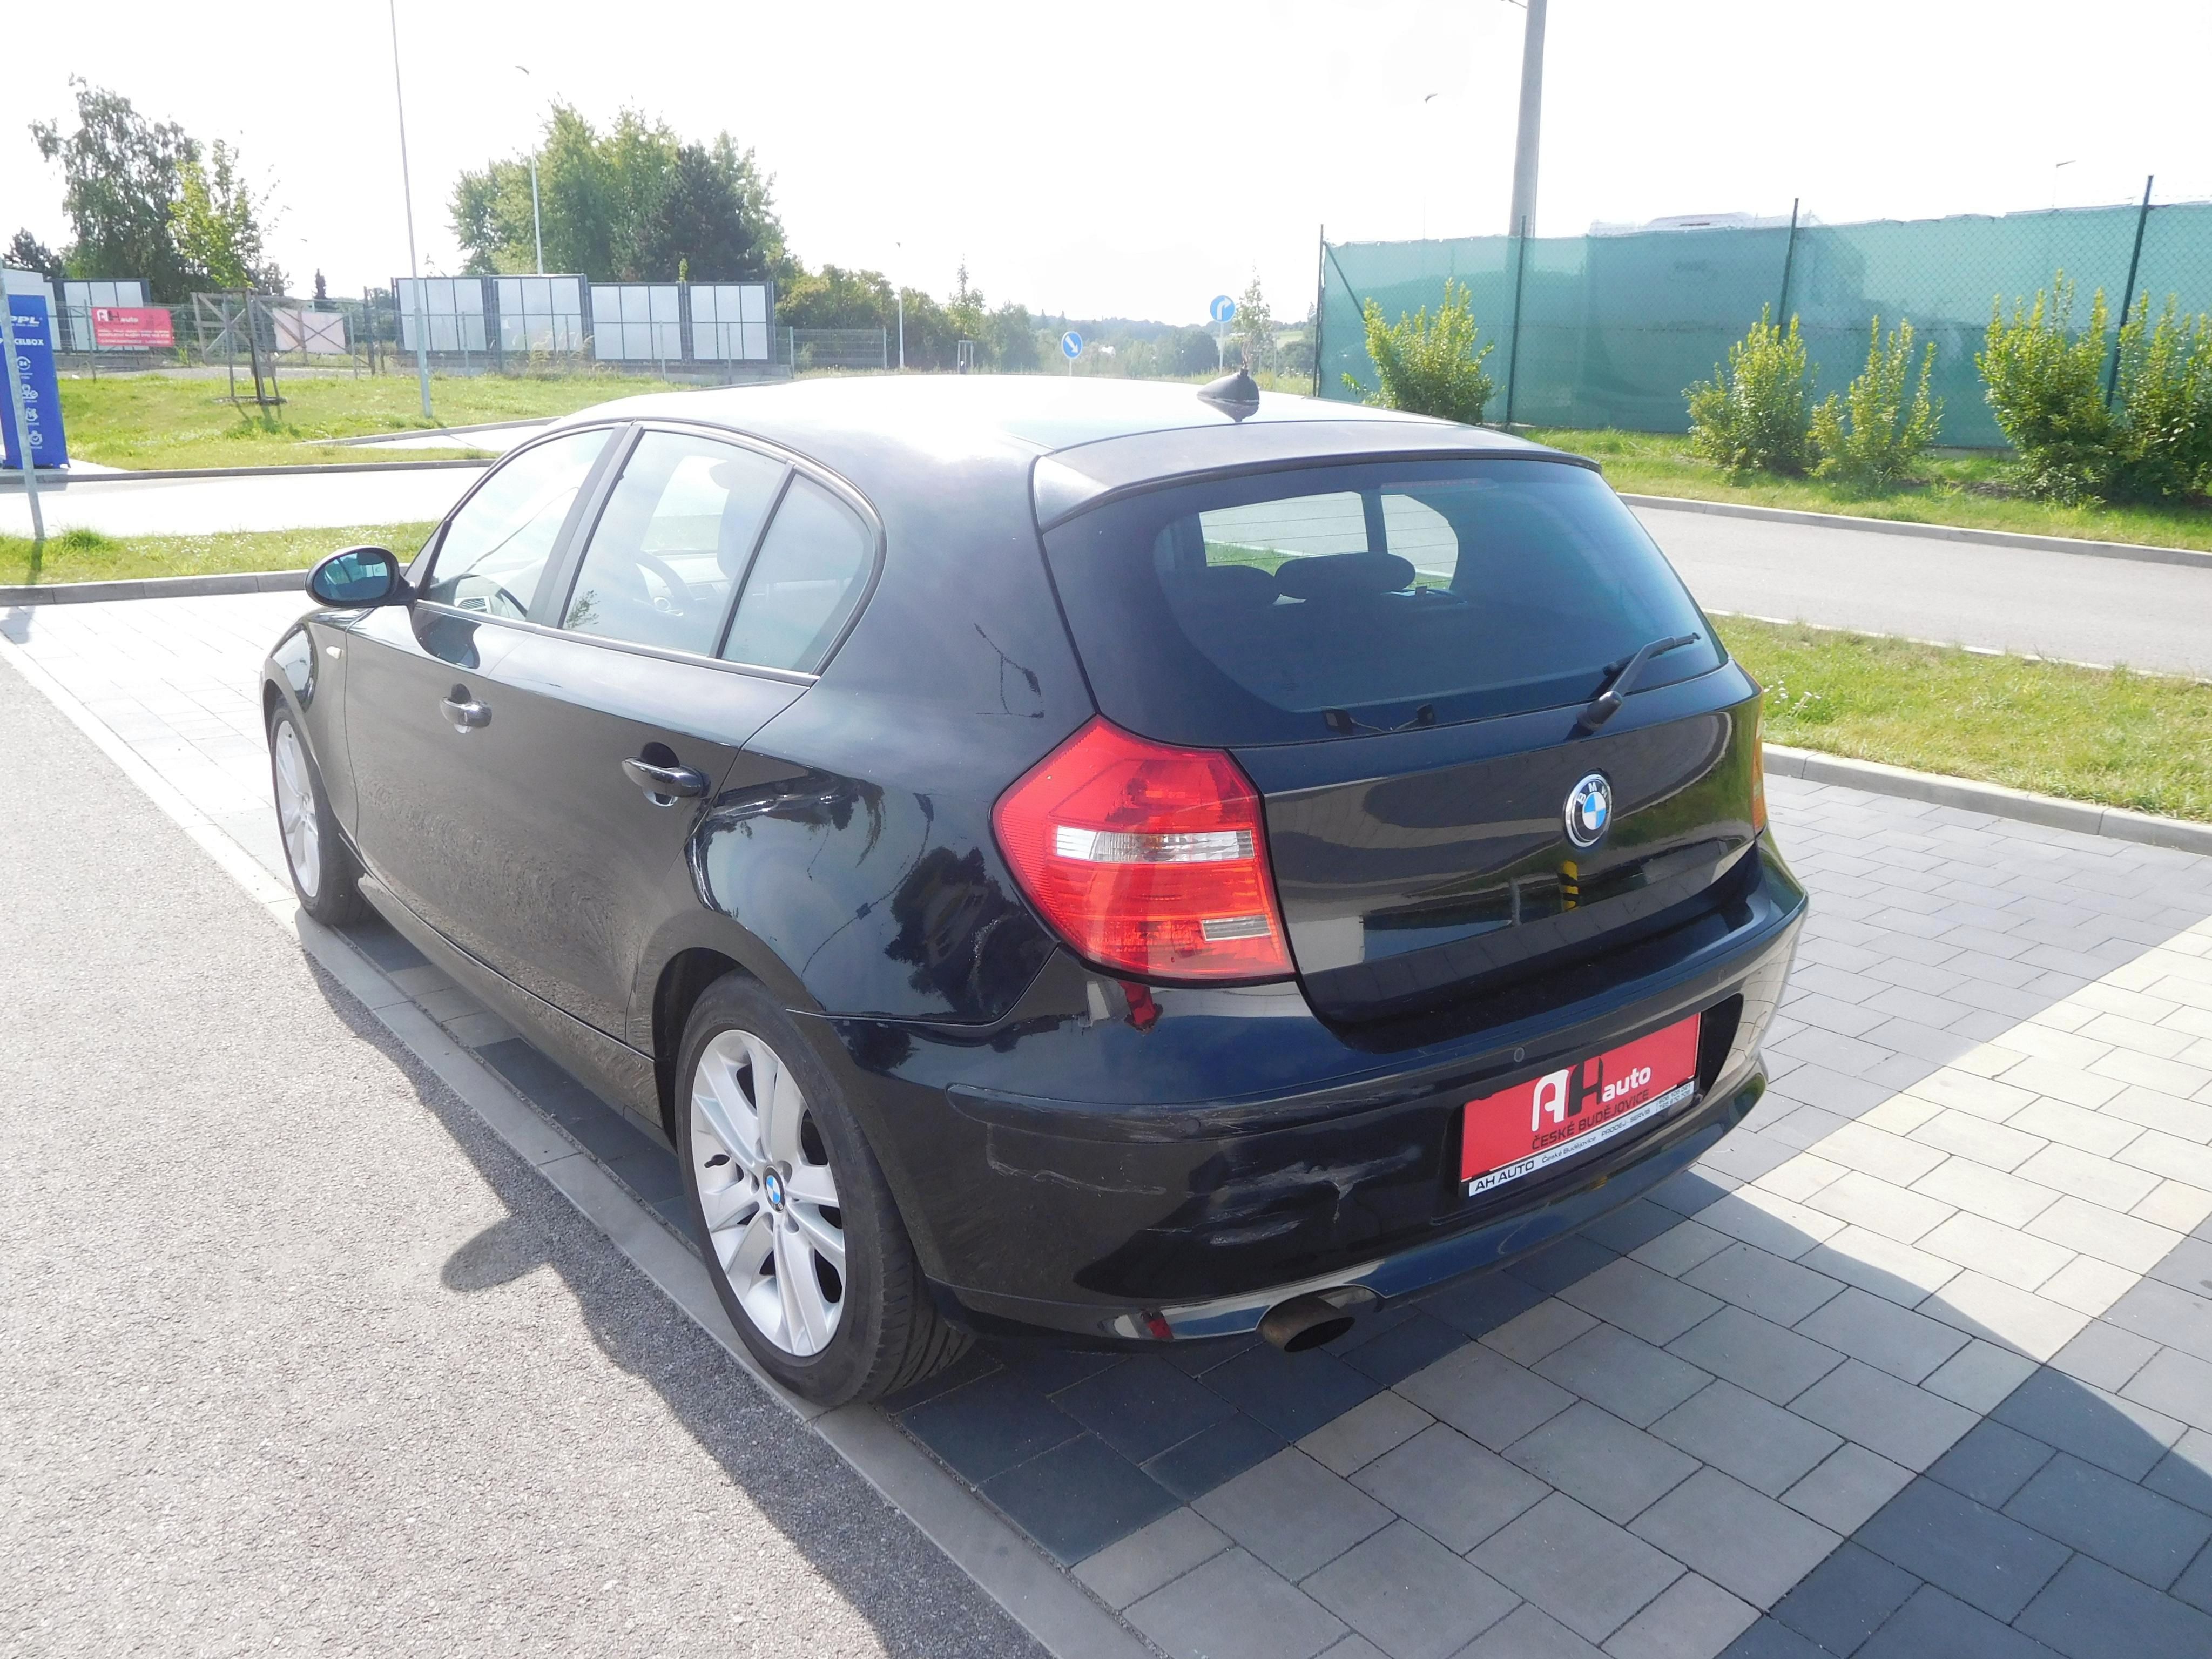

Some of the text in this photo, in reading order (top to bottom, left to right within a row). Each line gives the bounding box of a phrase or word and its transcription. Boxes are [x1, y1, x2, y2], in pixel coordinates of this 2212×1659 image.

[1576, 781, 1608, 805] BMW
[1532, 1057, 1651, 1132] AH auto
[1532, 1121, 1575, 1150] ČESKÉ
[1578, 1088, 1649, 1133] BUDĚJOVICE
[1475, 1176, 1495, 1192] AH
[1498, 1159, 1534, 1183] AUTO
[1542, 1150, 1562, 1163] České
[1563, 1136, 1597, 1154] Budějovice
[1601, 1120, 1627, 1137] PRODEJ
[1630, 1108, 1651, 1123] SERVIS
